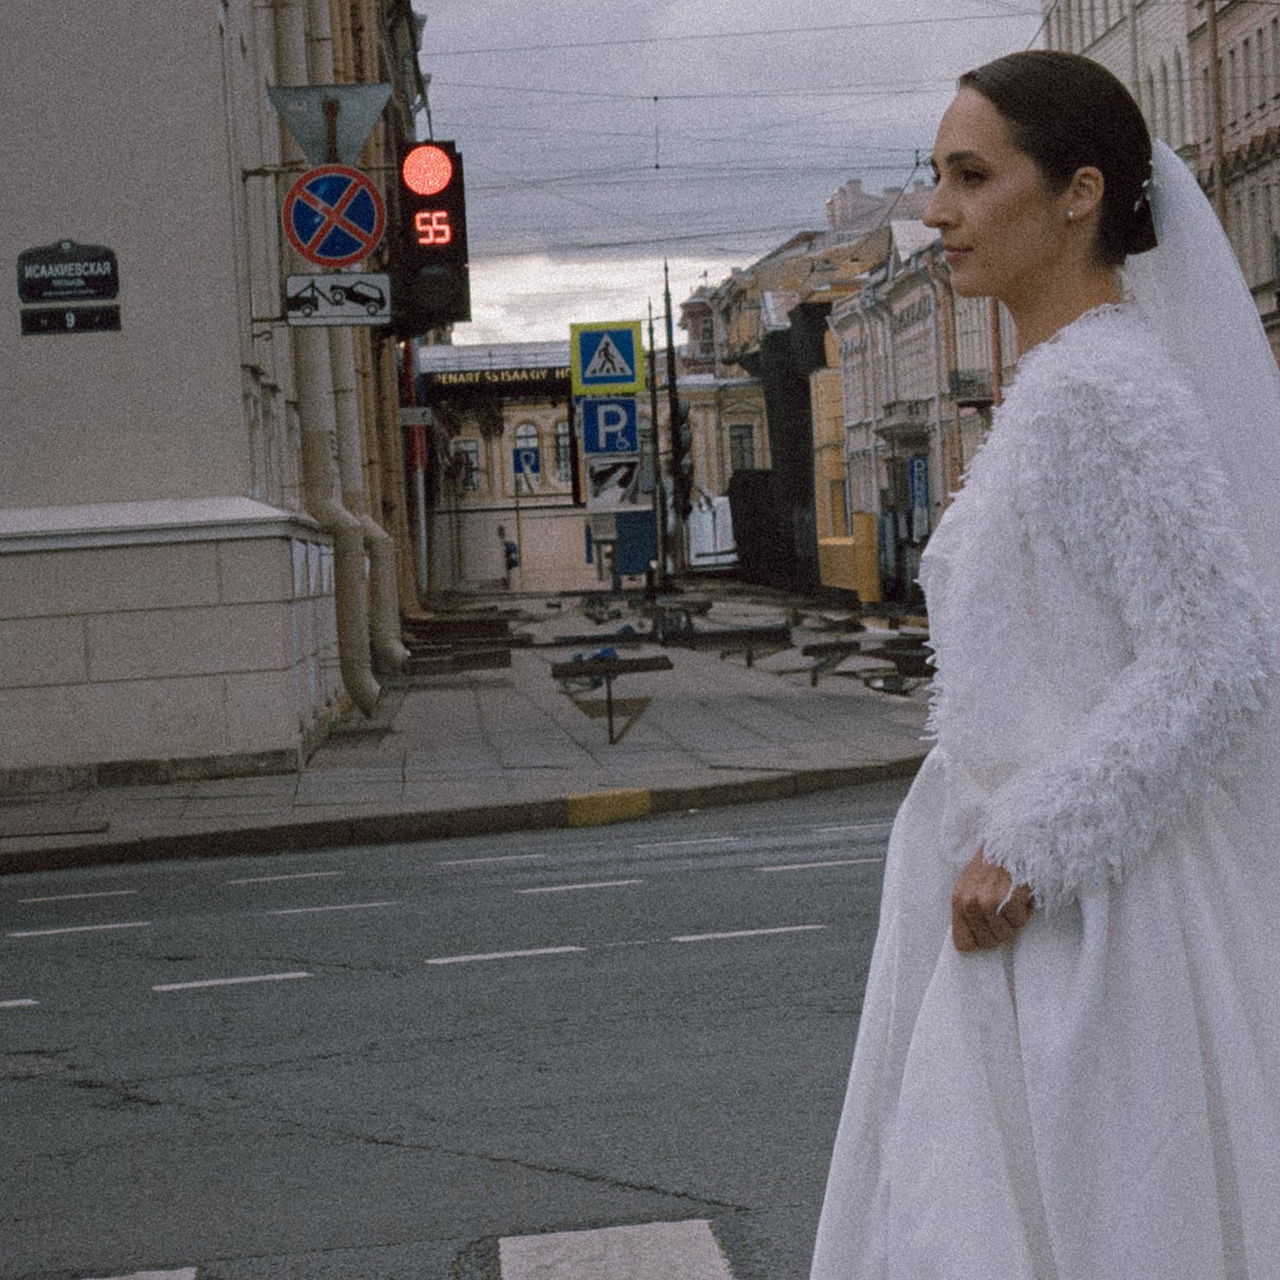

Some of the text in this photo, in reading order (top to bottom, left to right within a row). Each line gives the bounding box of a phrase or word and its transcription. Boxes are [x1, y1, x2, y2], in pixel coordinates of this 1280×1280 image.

[415, 211, 451, 245] 55
[24, 261, 111, 278] ИСААКИЕВСКАЯ
[65, 312, 75, 328] 9
[597, 405, 626, 448] P
